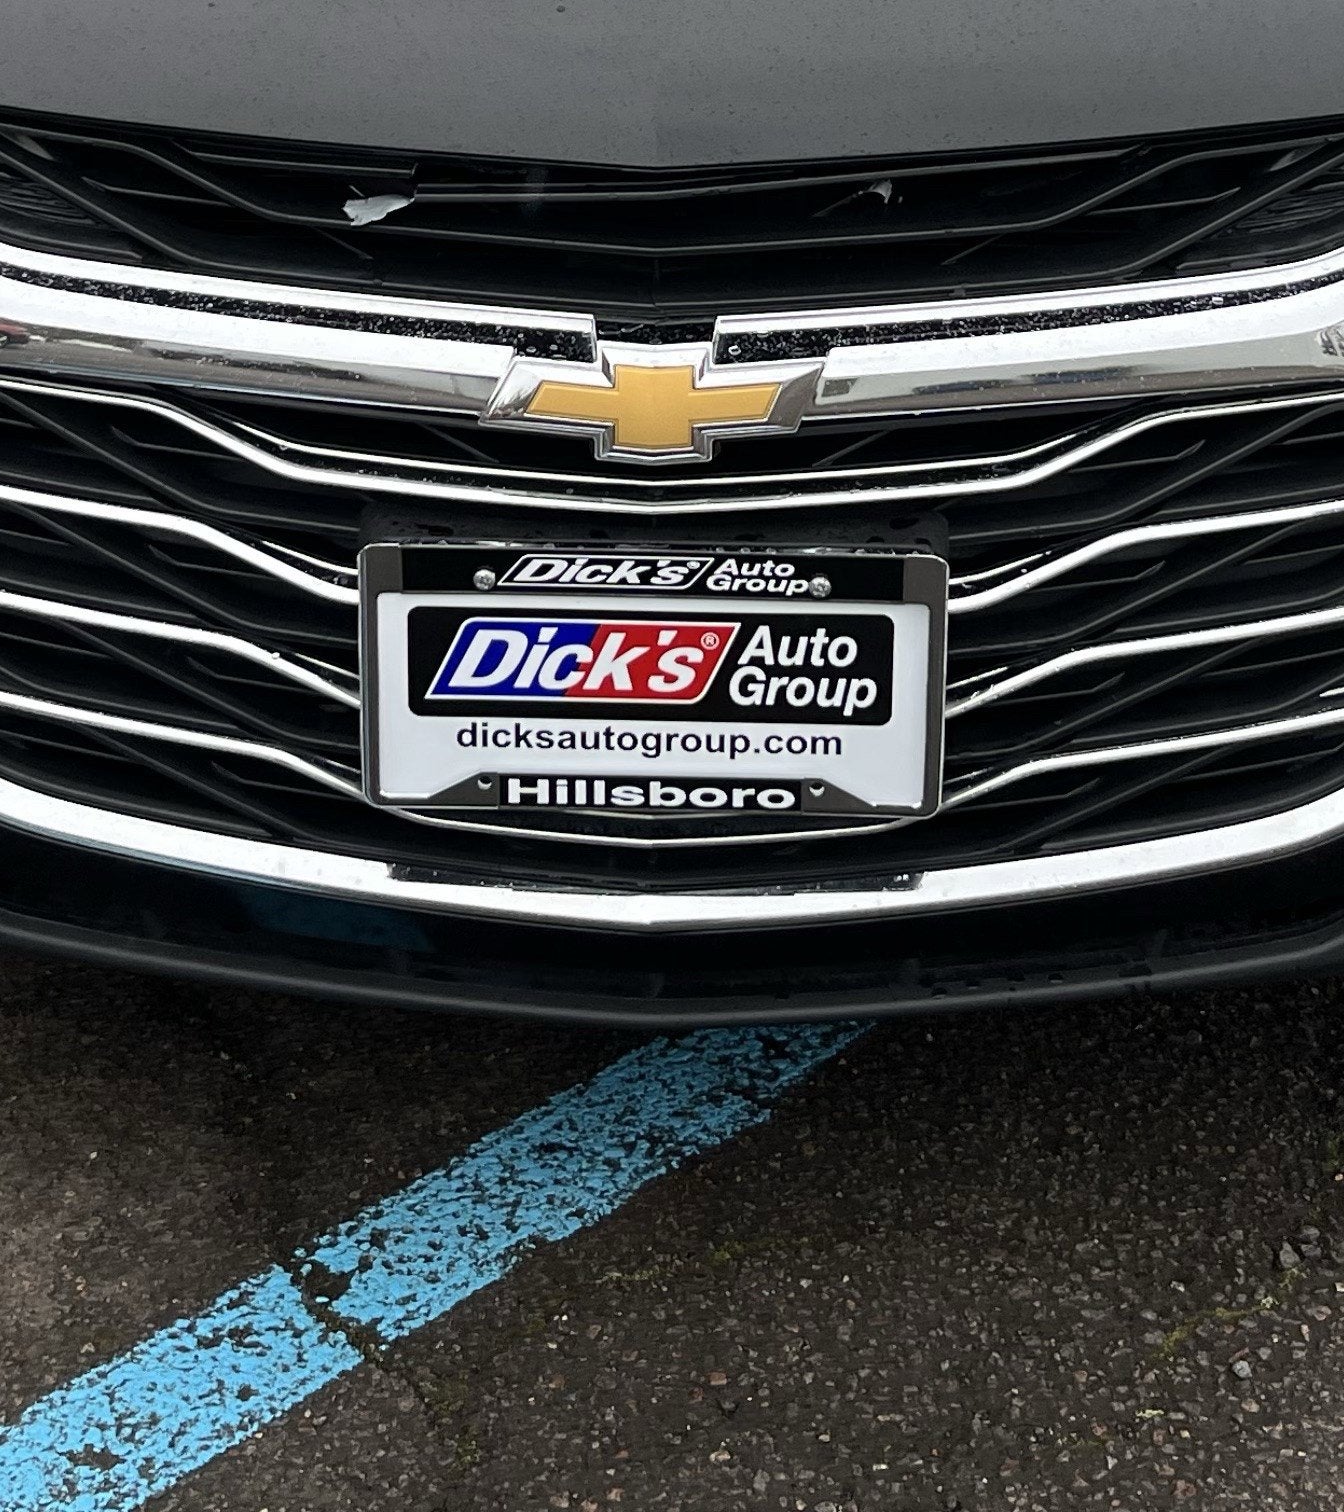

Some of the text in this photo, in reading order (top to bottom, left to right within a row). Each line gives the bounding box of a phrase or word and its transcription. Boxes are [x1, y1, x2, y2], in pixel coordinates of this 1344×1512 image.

[512, 558, 796, 586] Dick's Auto
[706, 574, 809, 596] Group
[447, 625, 858, 693] Dick's Auto
[729, 667, 878, 717] Group
[455, 722, 843, 760] dicksautogroup.com
[506, 777, 796, 810] Hillsboro
